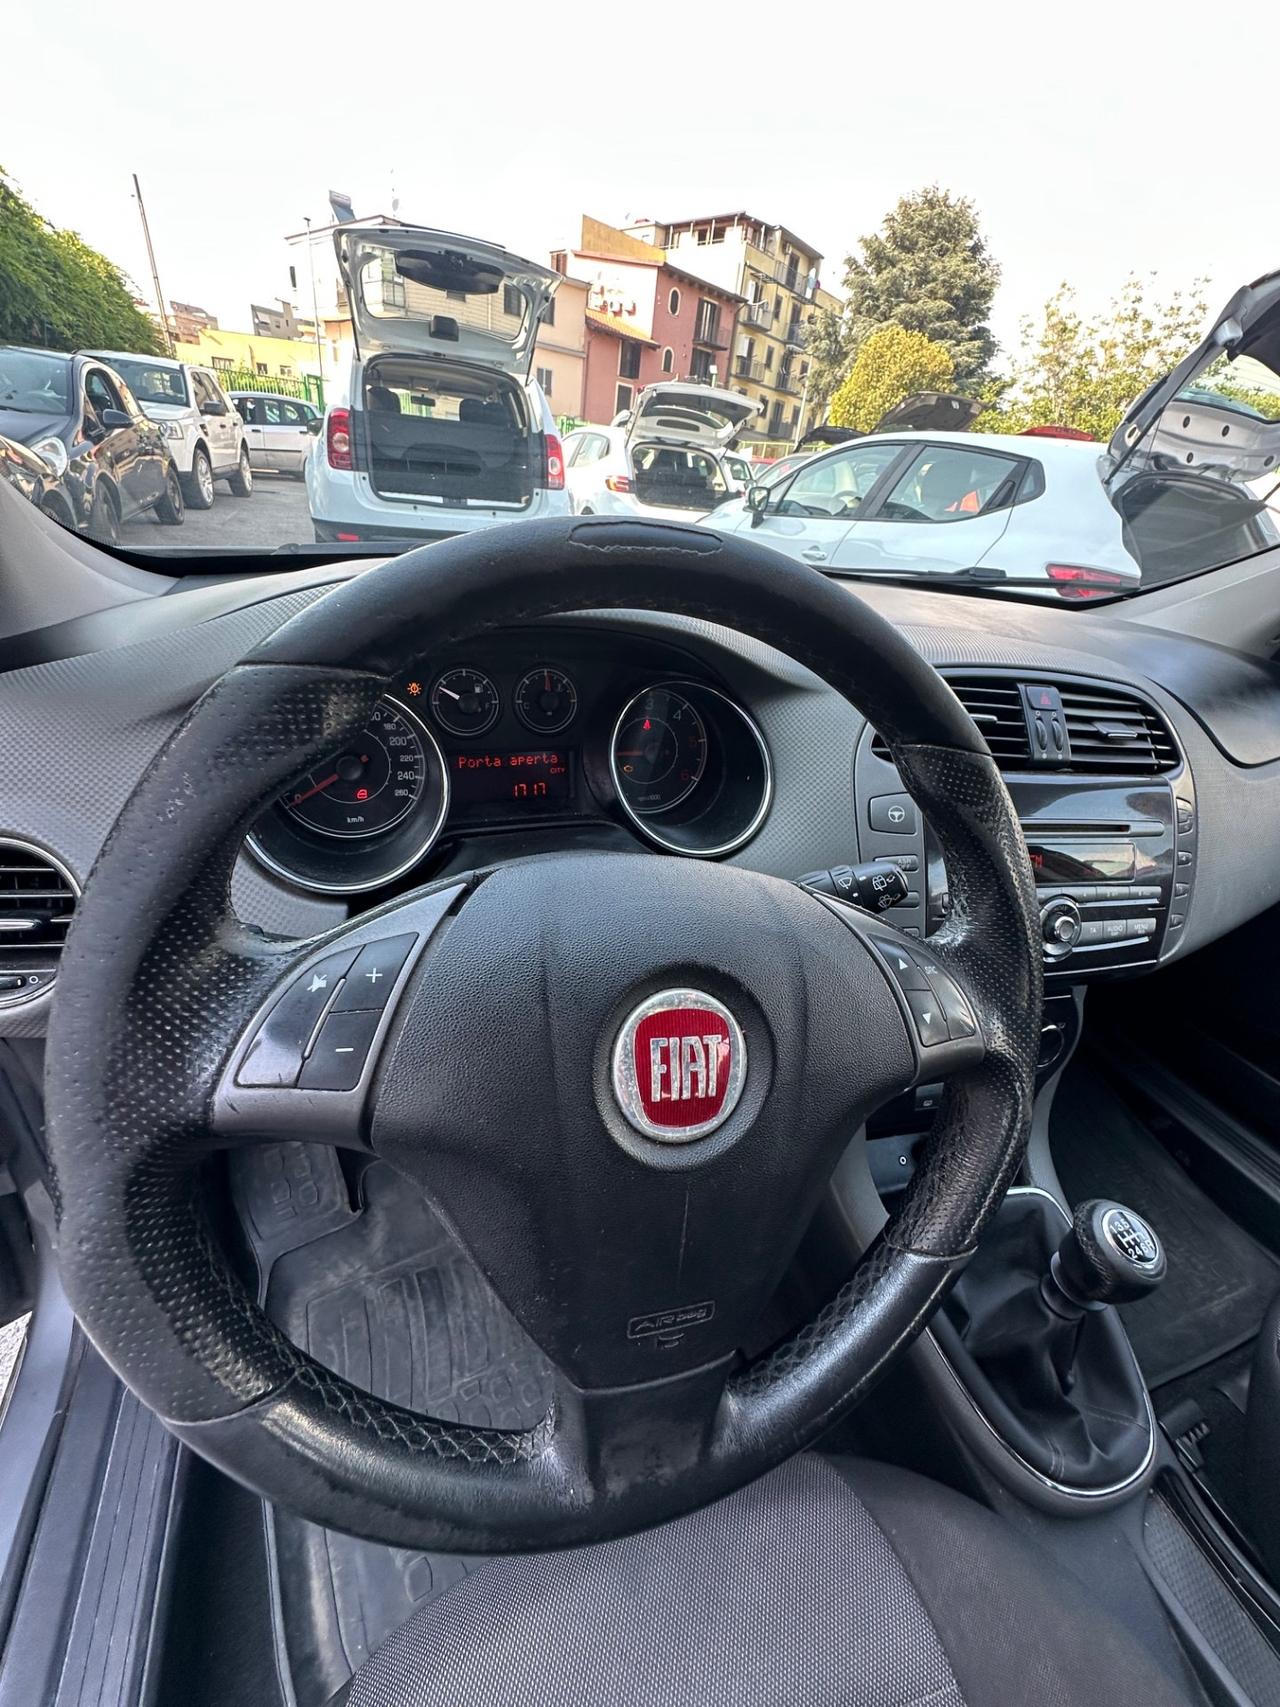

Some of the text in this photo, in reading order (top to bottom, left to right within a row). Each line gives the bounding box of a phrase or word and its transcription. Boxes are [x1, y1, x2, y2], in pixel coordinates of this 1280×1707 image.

[672, 710, 682, 721] 4
[389, 736, 407, 746] 200
[399, 754, 414, 762] 220
[458, 752, 559, 769] Porta aperta
[397, 771, 415, 781] 240
[394, 789, 409, 797] 260
[346, 816, 365, 824] km/h
[649, 1034, 722, 1103] FIAT
